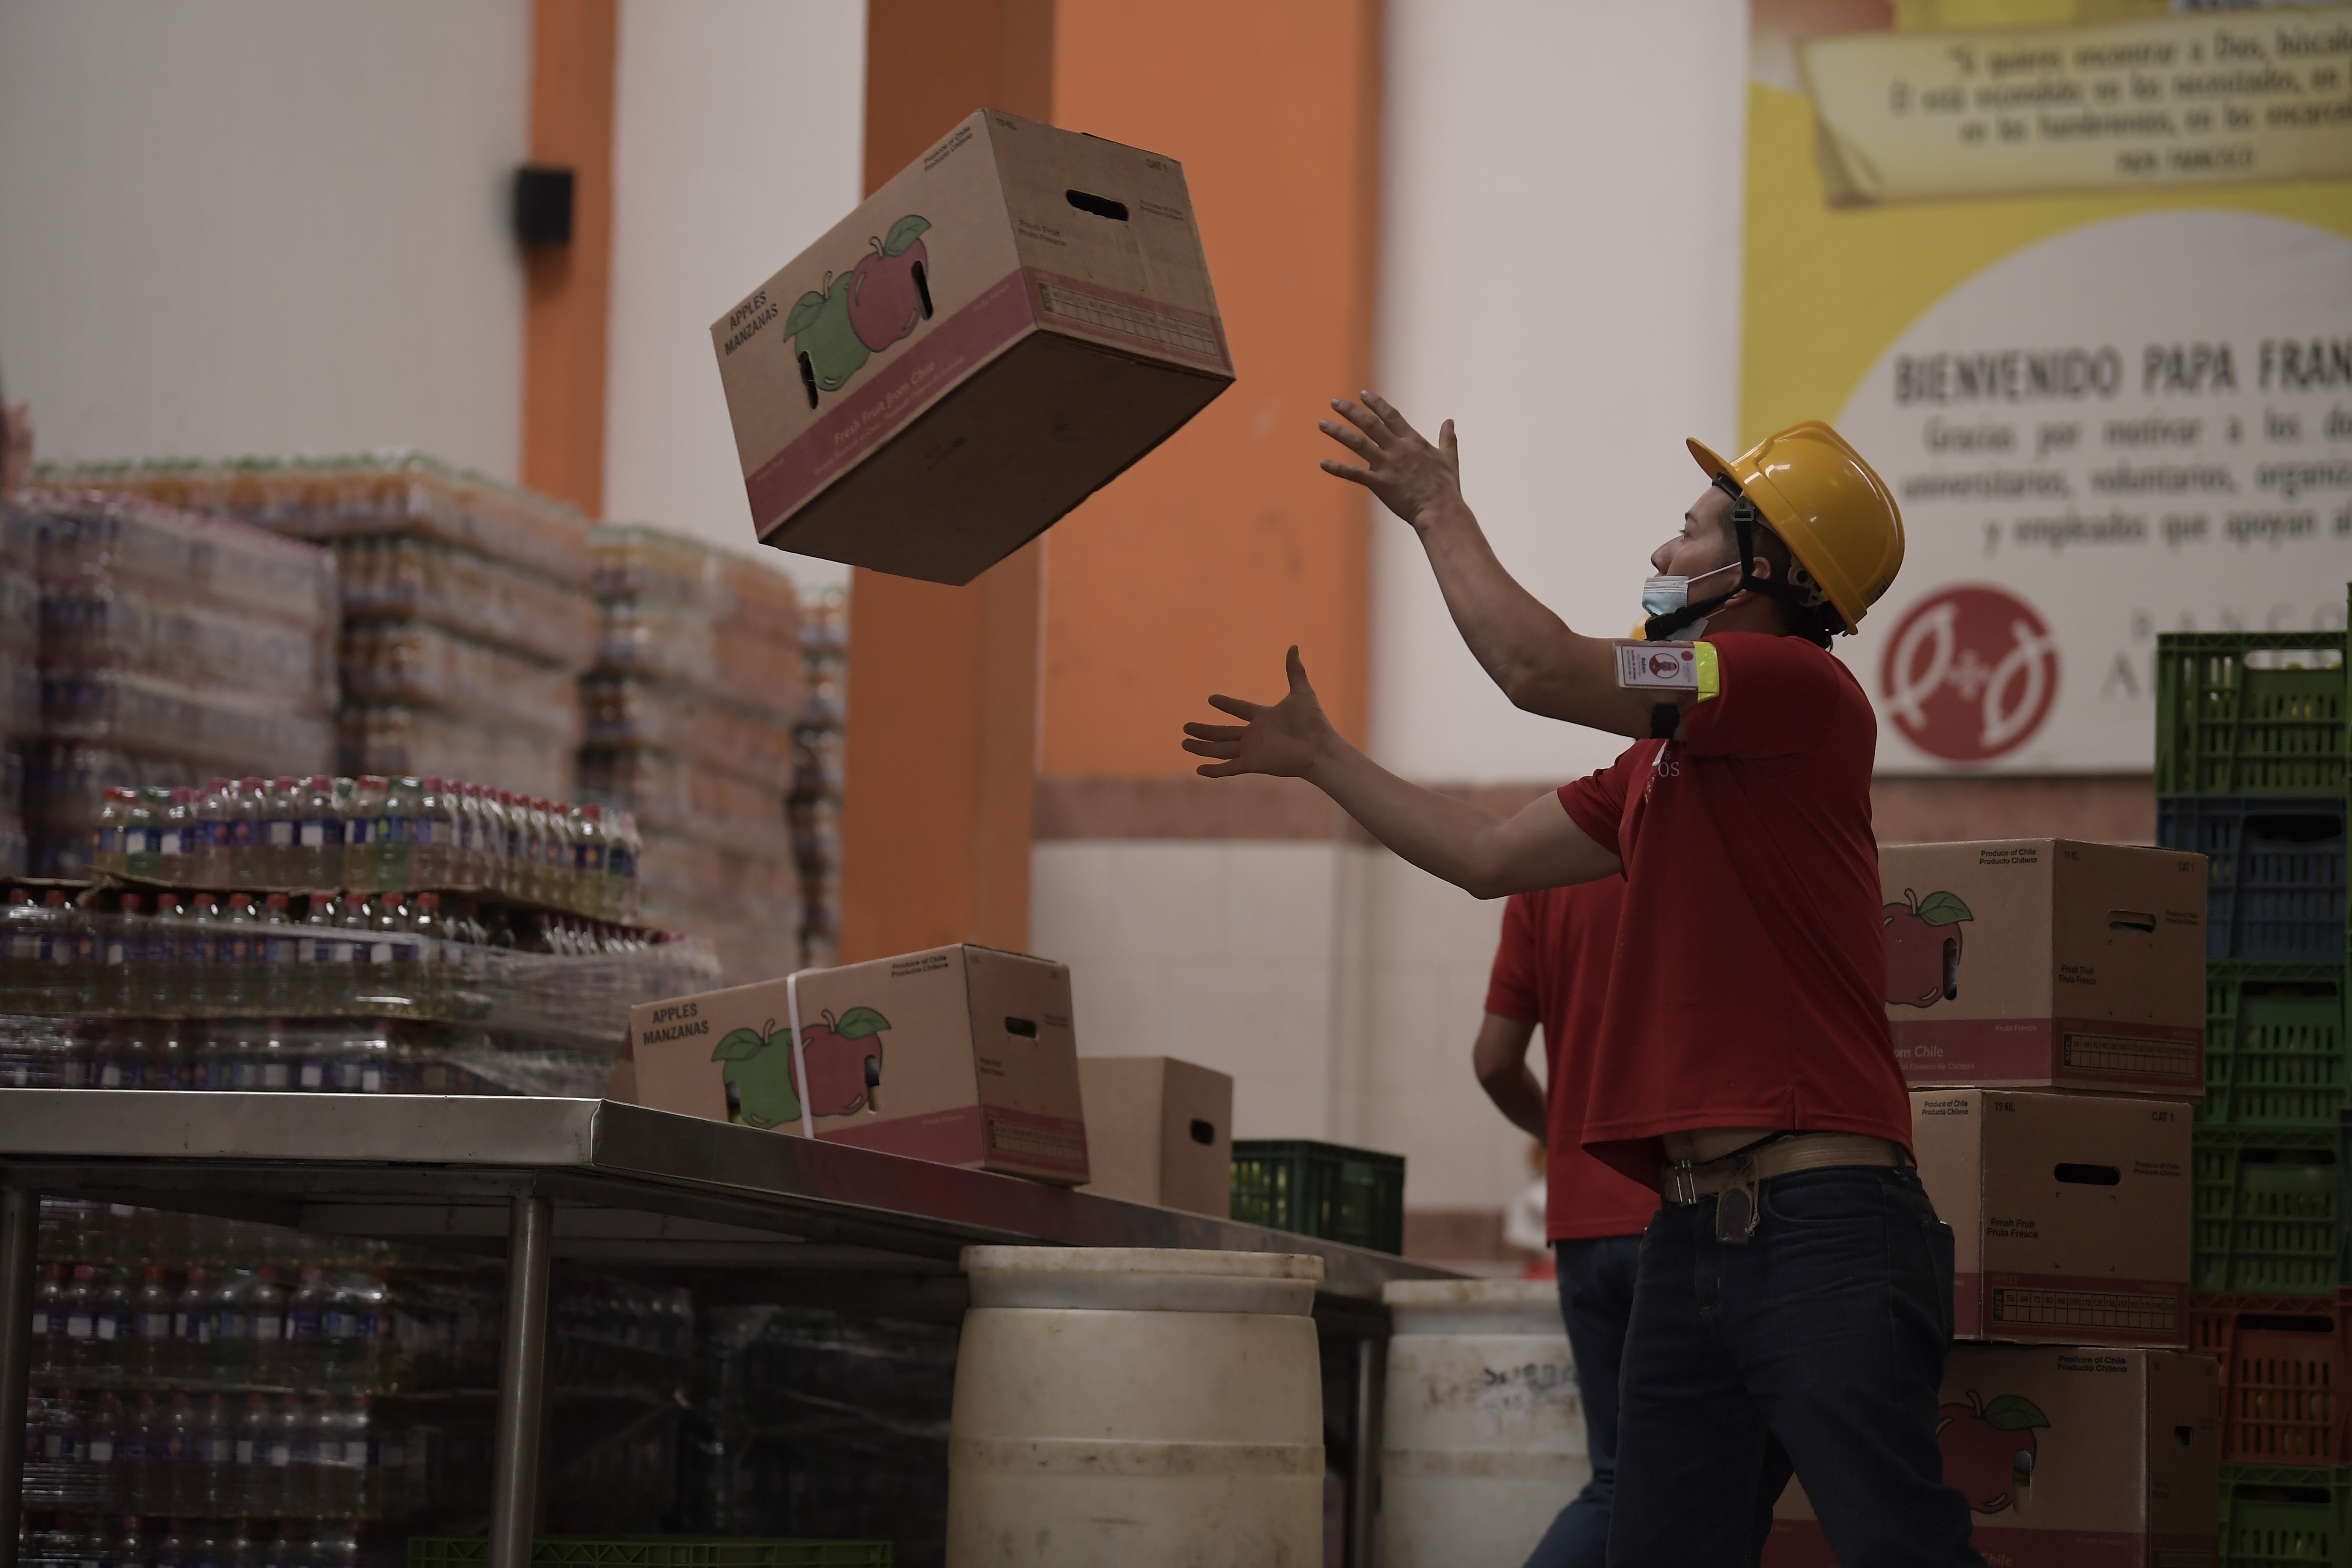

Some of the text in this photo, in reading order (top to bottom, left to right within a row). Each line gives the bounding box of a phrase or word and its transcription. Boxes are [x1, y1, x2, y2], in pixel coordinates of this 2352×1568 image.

[730, 290, 767, 330] APPLES
[724, 302, 778, 356] MANZANAS
[1897, 346, 2121, 406] BIENVENIDO
[2144, 341, 2239, 396] PAPA
[834, 419, 861, 446] Fresh
[861, 401, 886, 424] Fruit
[886, 382, 910, 408] from
[653, 1002, 697, 1024] APPLES
[643, 1020, 708, 1045] MANZANAS
[1894, 1045, 1944, 1057] om Chile
[2152, 1111, 2168, 1122] CAT
[1987, 1228, 2038, 1238] Fruta Fresca
[1991, 1218, 2034, 1228] Fresh Fruit
[1995, 1294, 2003, 1315] SIZE
